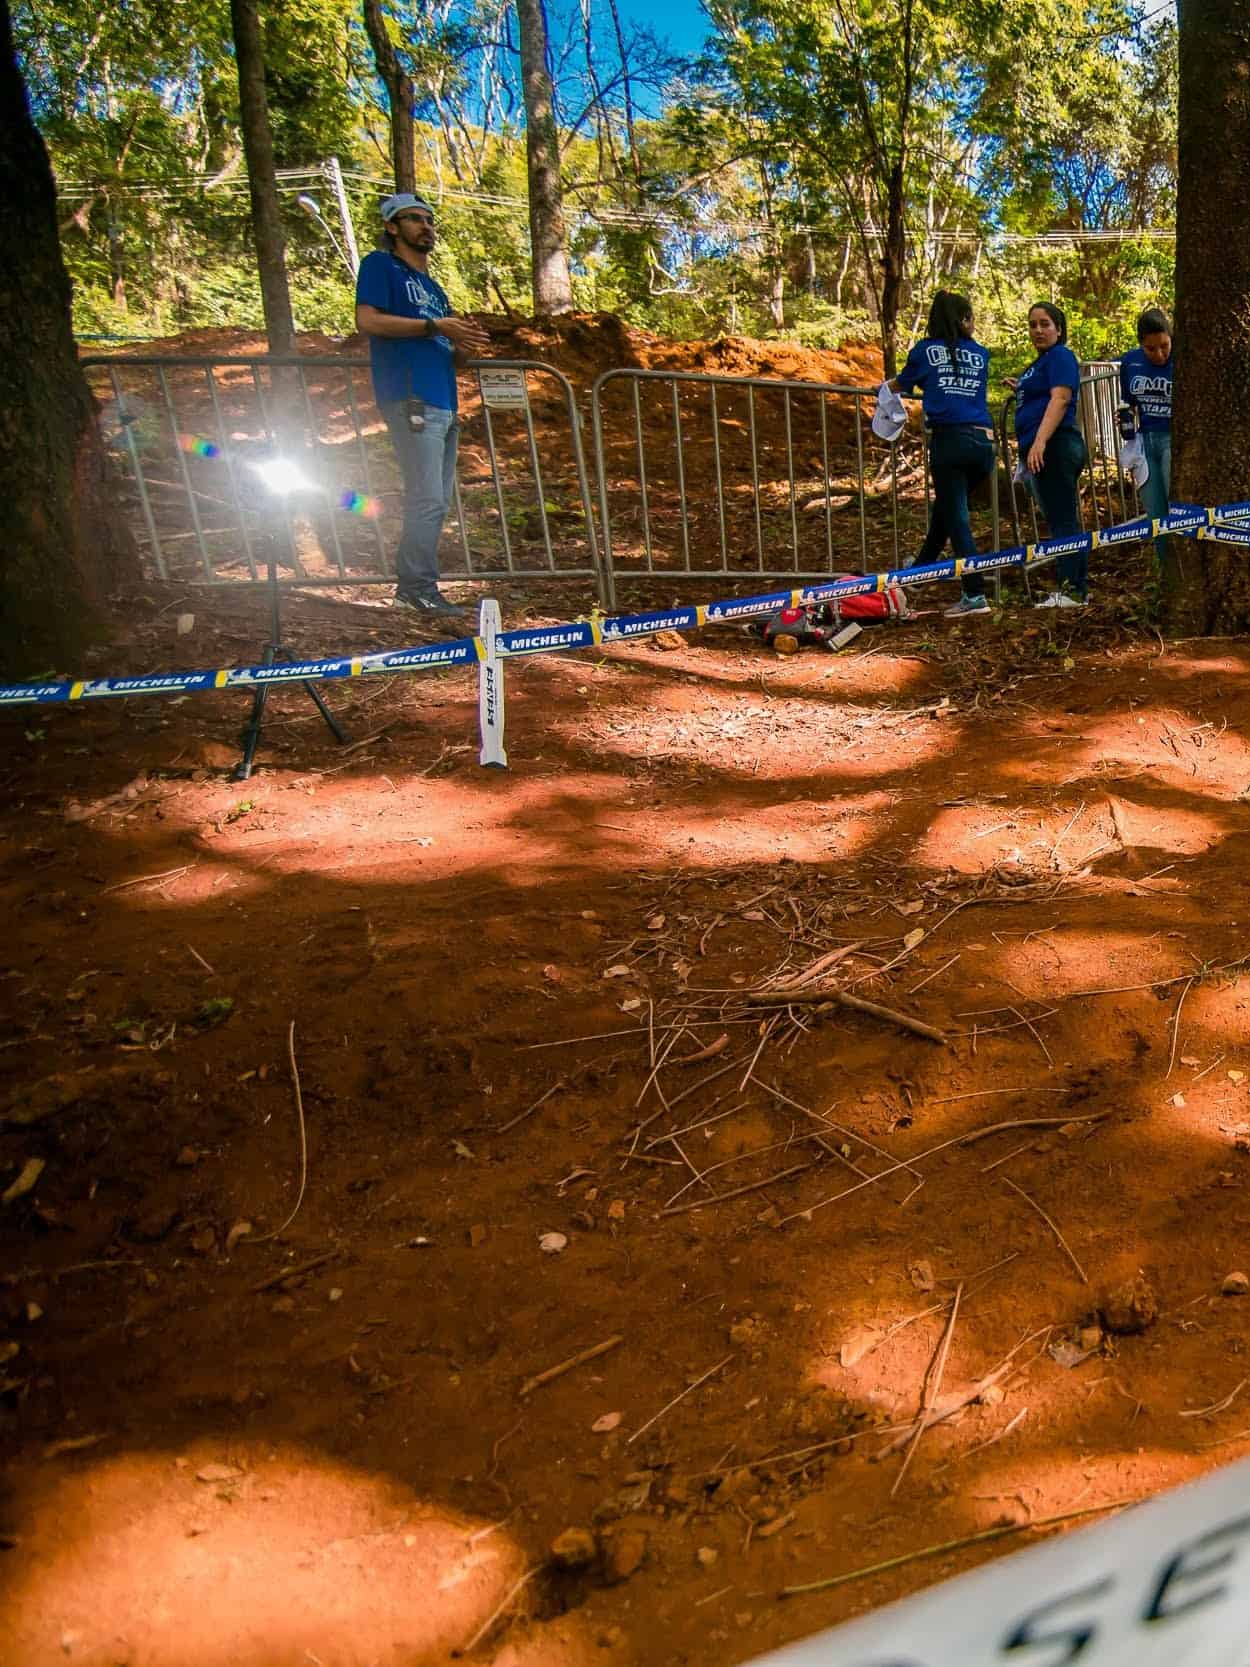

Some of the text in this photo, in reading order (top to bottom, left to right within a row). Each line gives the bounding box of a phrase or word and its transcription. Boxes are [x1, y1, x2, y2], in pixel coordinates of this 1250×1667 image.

[938, 377, 981, 389] STAFF
[113, 675, 206, 689] MICHELIN
[255, 663, 341, 678] MICHELIN
[388, 648, 467, 665] MICHELIN
[510, 631, 584, 650] MICHELIN
[623, 614, 689, 634] MICHELIN
[725, 599, 785, 617] MICHELIN
[818, 582, 872, 599] MICHELIN
[901, 567, 951, 584] MICHELIN
[977, 553, 1022, 569] MICHELIN
[1046, 539, 1088, 555] MICHELIN
[1110, 527, 1149, 541] MICHELIN
[1169, 515, 1206, 529] MICHELIN
